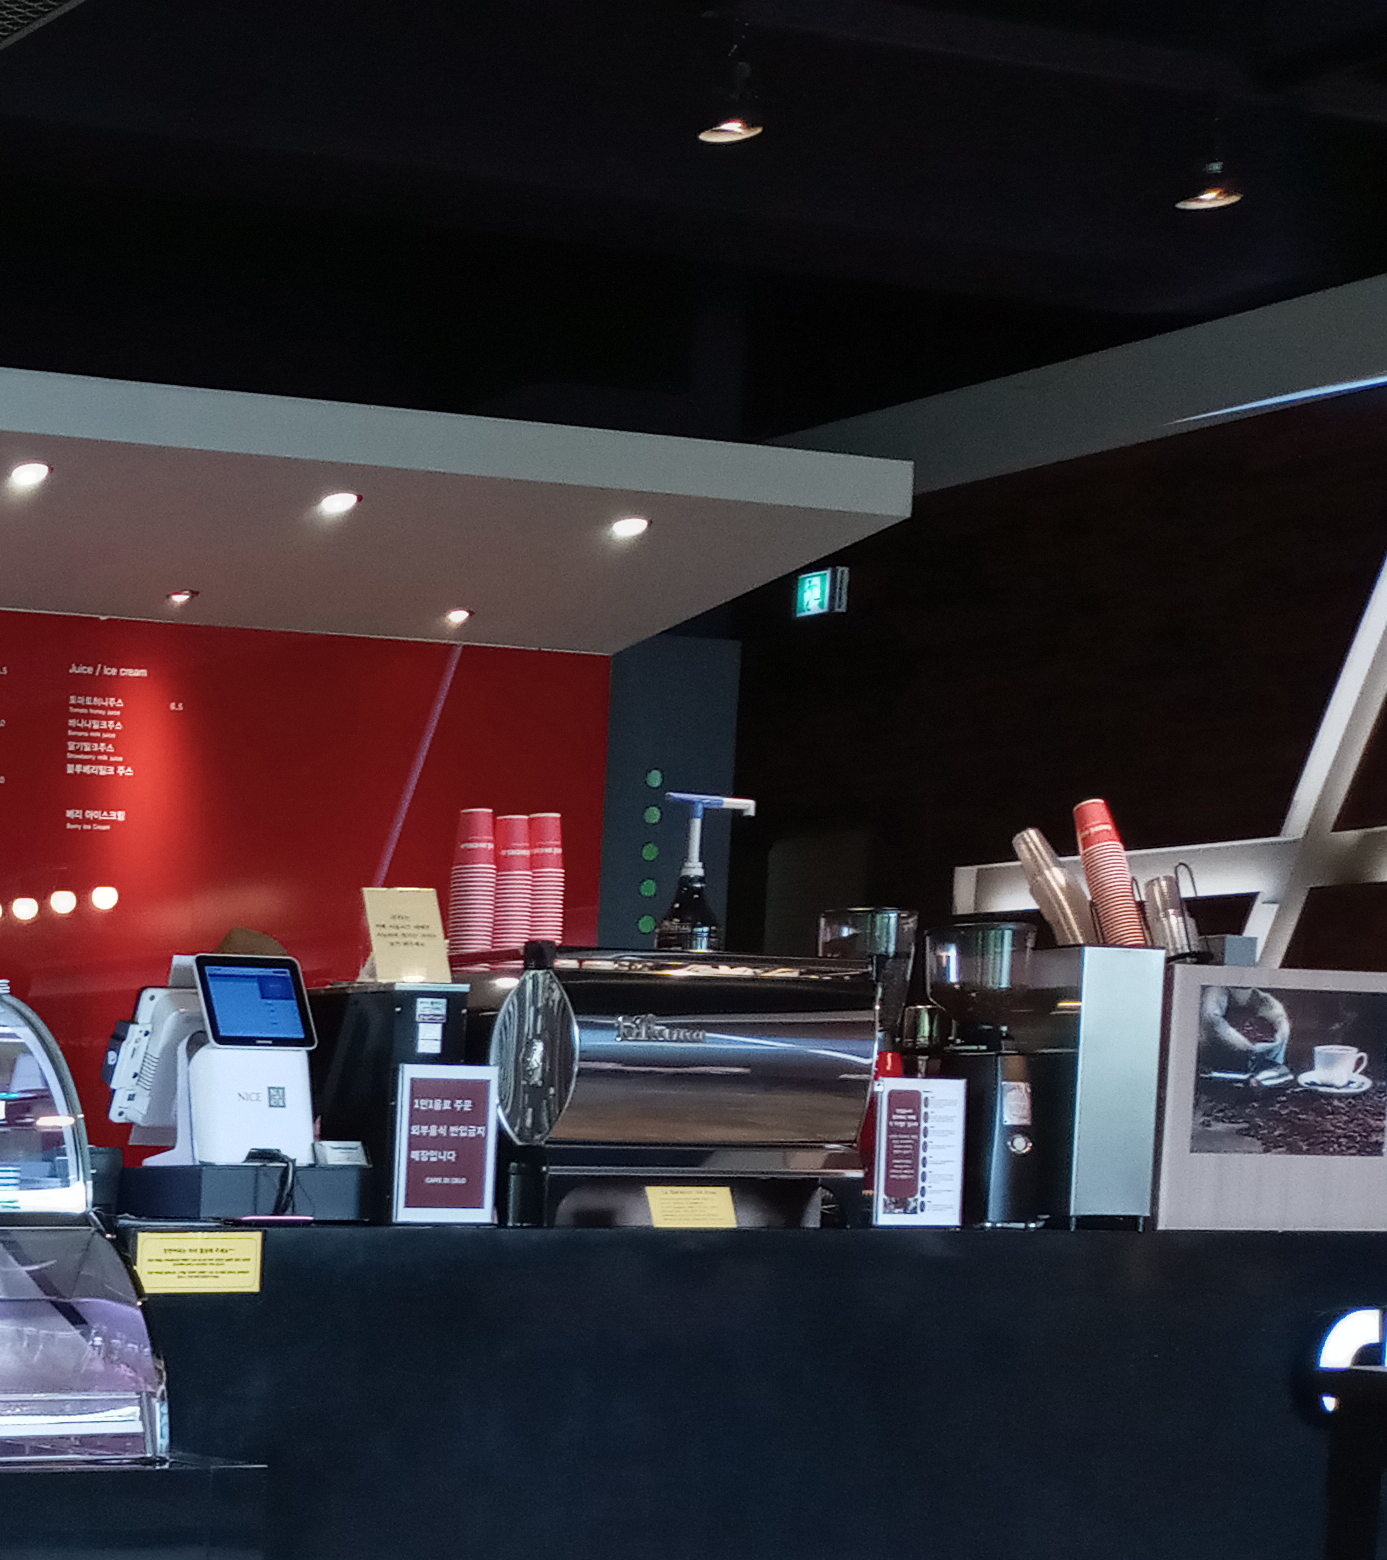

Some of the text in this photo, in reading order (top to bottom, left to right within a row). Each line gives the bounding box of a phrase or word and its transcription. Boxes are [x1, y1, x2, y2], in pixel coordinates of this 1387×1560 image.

[69, 663, 94, 675] Juice
[119, 667, 148, 677] cream
[116, 765, 134, 776] 주스
[84, 810, 126, 821] 아이스크림
[237, 1092, 262, 1102] NICE
[414, 1099, 473, 1112] 1인1음료 주문
[410, 1125, 486, 1138] 외부음식 반입금지
[411, 1150, 457, 1162] 매장입니다
